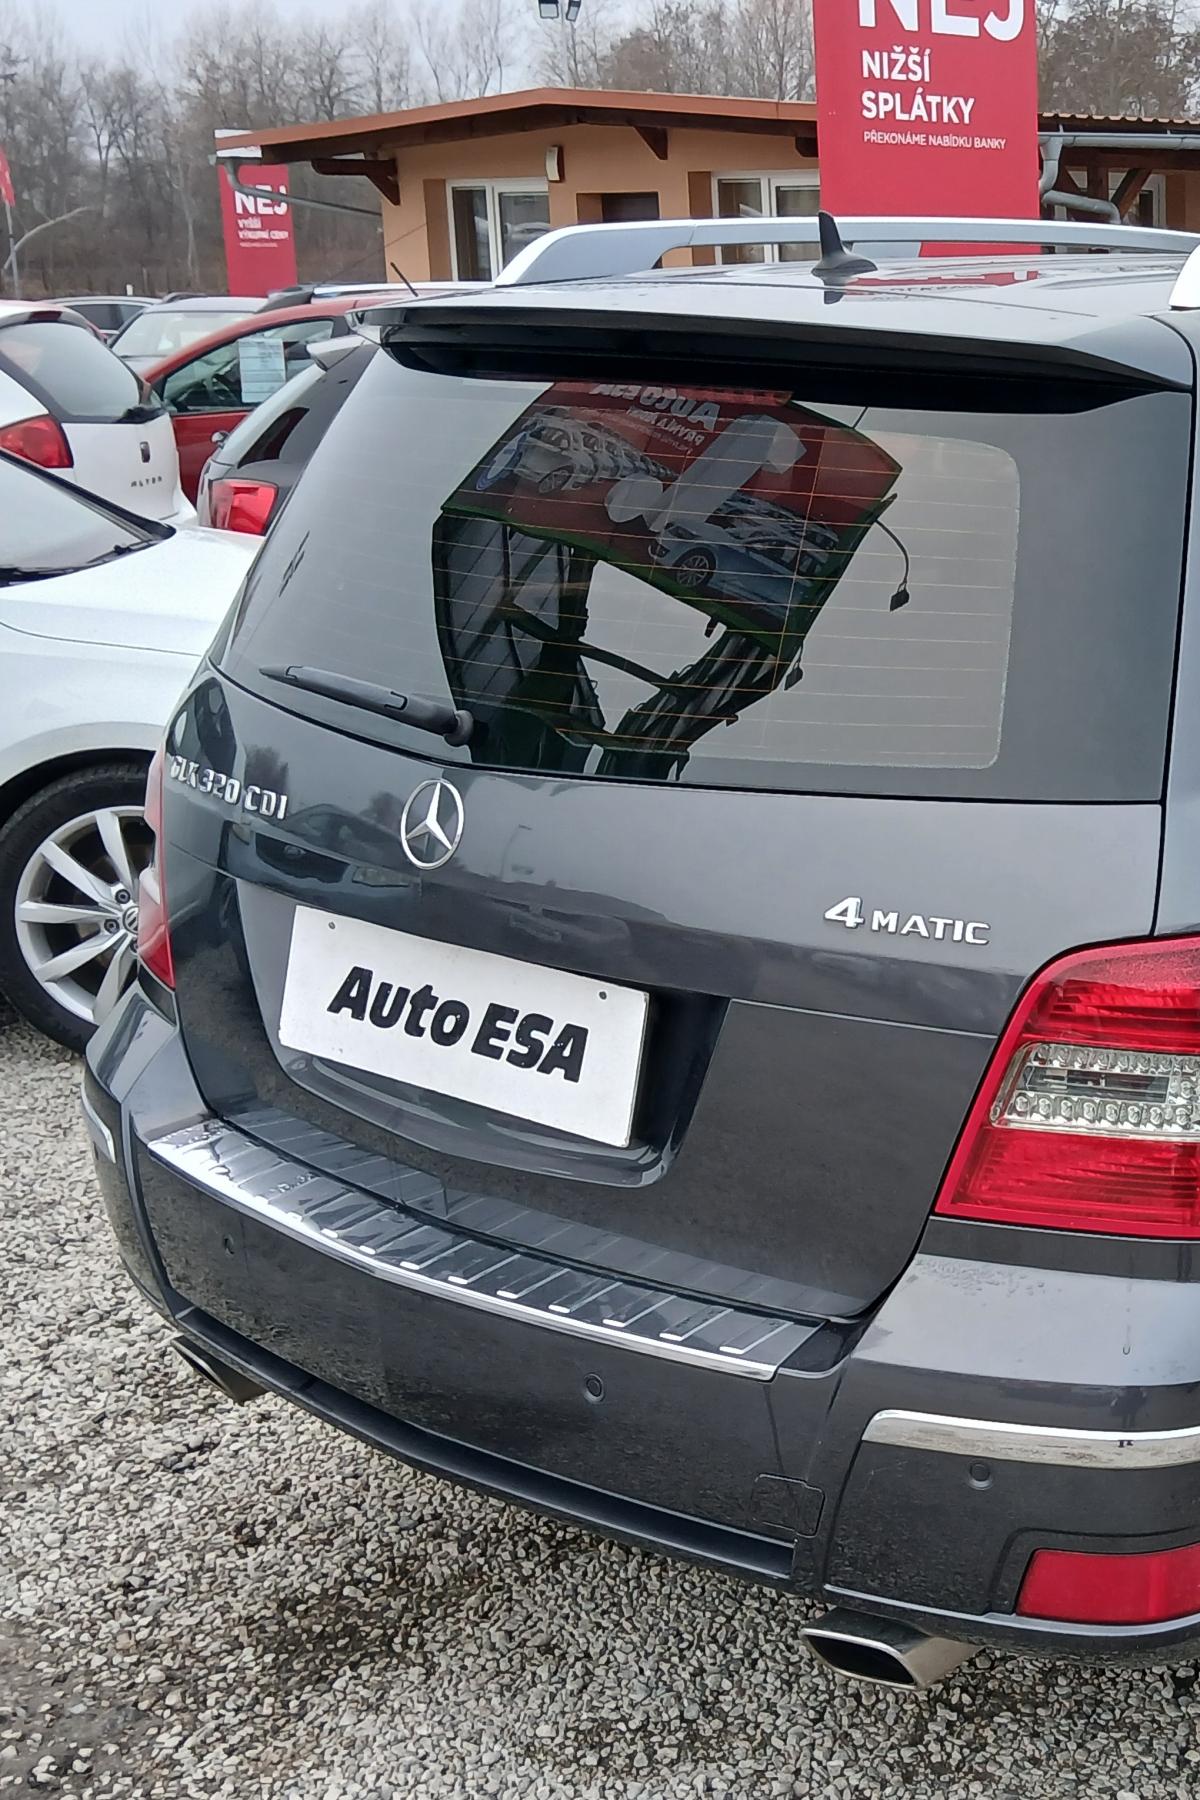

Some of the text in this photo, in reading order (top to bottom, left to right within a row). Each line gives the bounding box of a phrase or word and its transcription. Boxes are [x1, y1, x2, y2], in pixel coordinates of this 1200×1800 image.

[861, 45, 931, 82] NIŽŠÍ
[861, 87, 975, 124] SPLÁTKY
[863, 130, 1006, 150] PŘEKONÁME NABÍDKU BANKY
[235, 185, 288, 215] NEJ
[170, 755, 288, 819] GLK 320 CDI
[871, 909, 990, 944] MATIC
[327, 966, 589, 1083] Auto ESA
